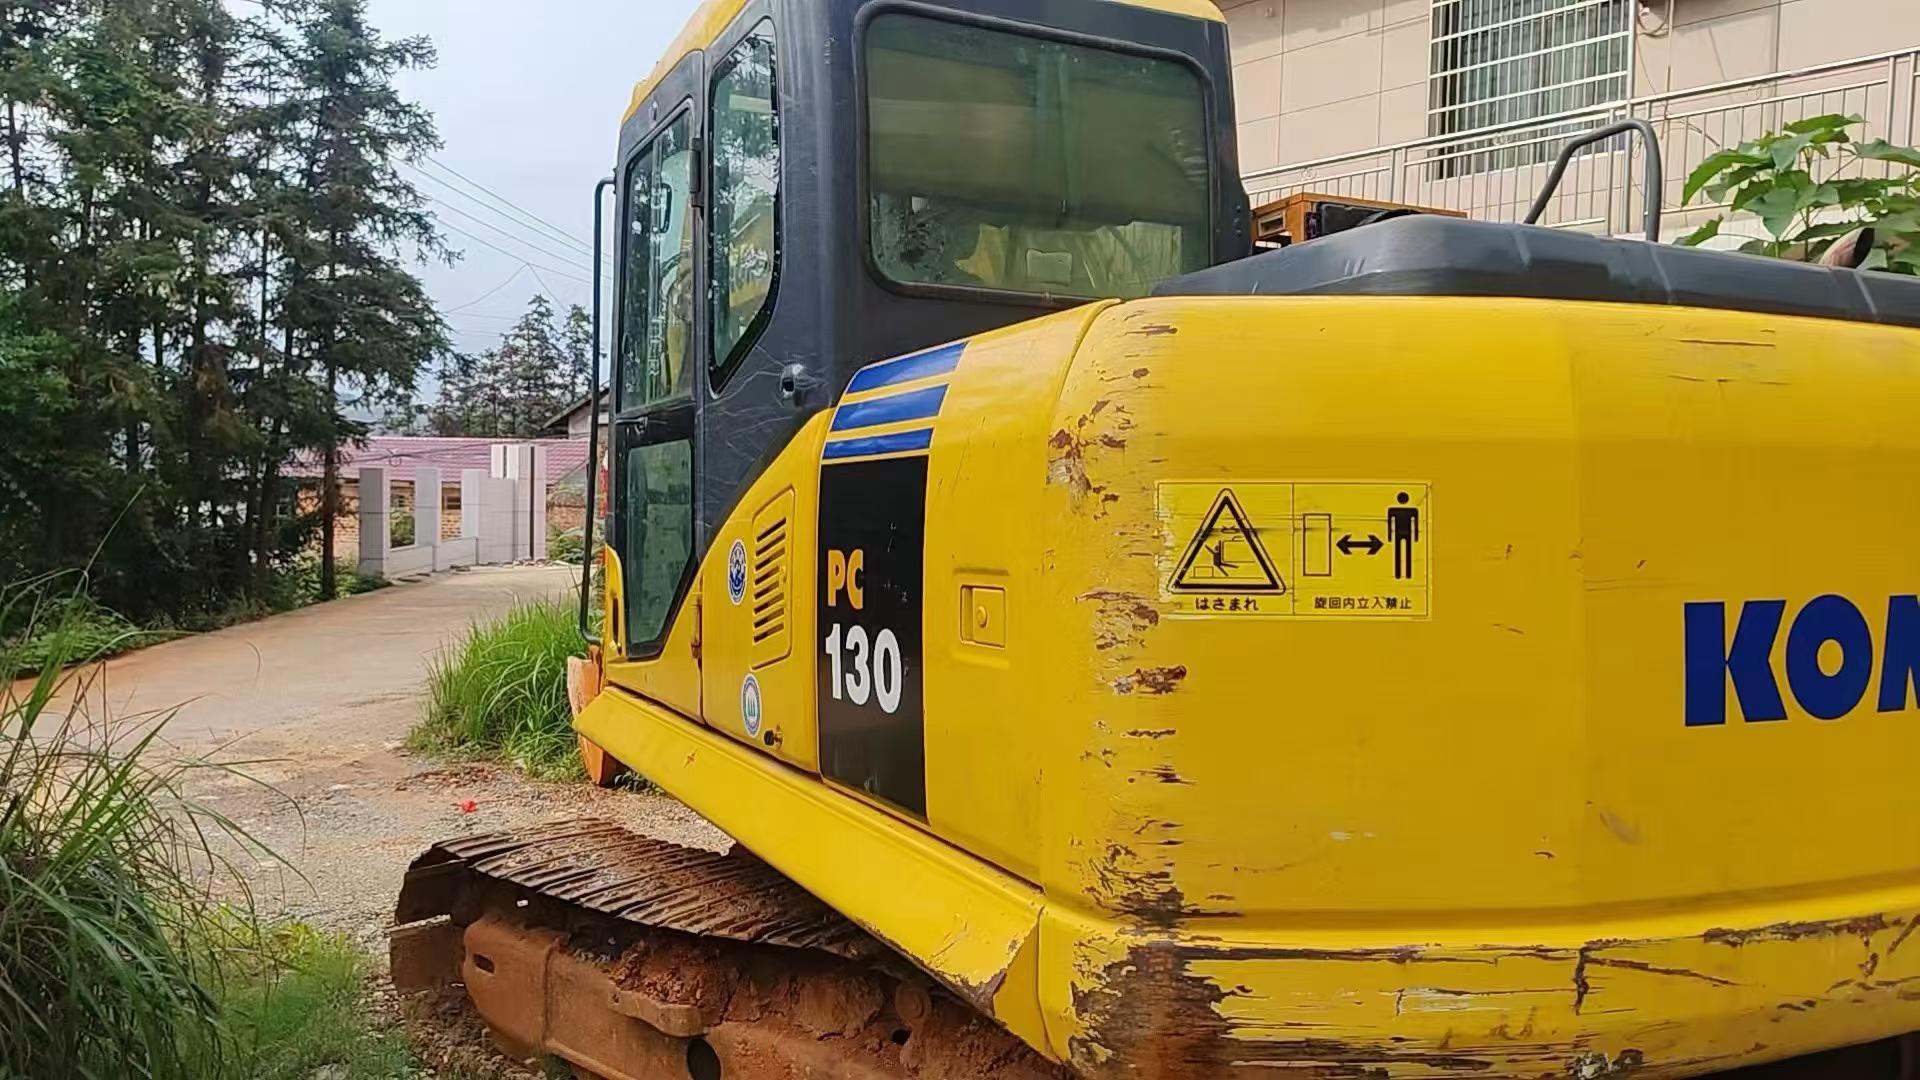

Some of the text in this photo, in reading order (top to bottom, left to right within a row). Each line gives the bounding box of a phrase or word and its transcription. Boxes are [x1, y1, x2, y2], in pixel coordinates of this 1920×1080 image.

[827, 548, 864, 610] PC
[1195, 596, 1259, 611] はさまれ
[1314, 596, 1412, 610] 旋回内立入禁止
[825, 622, 902, 714] 130
